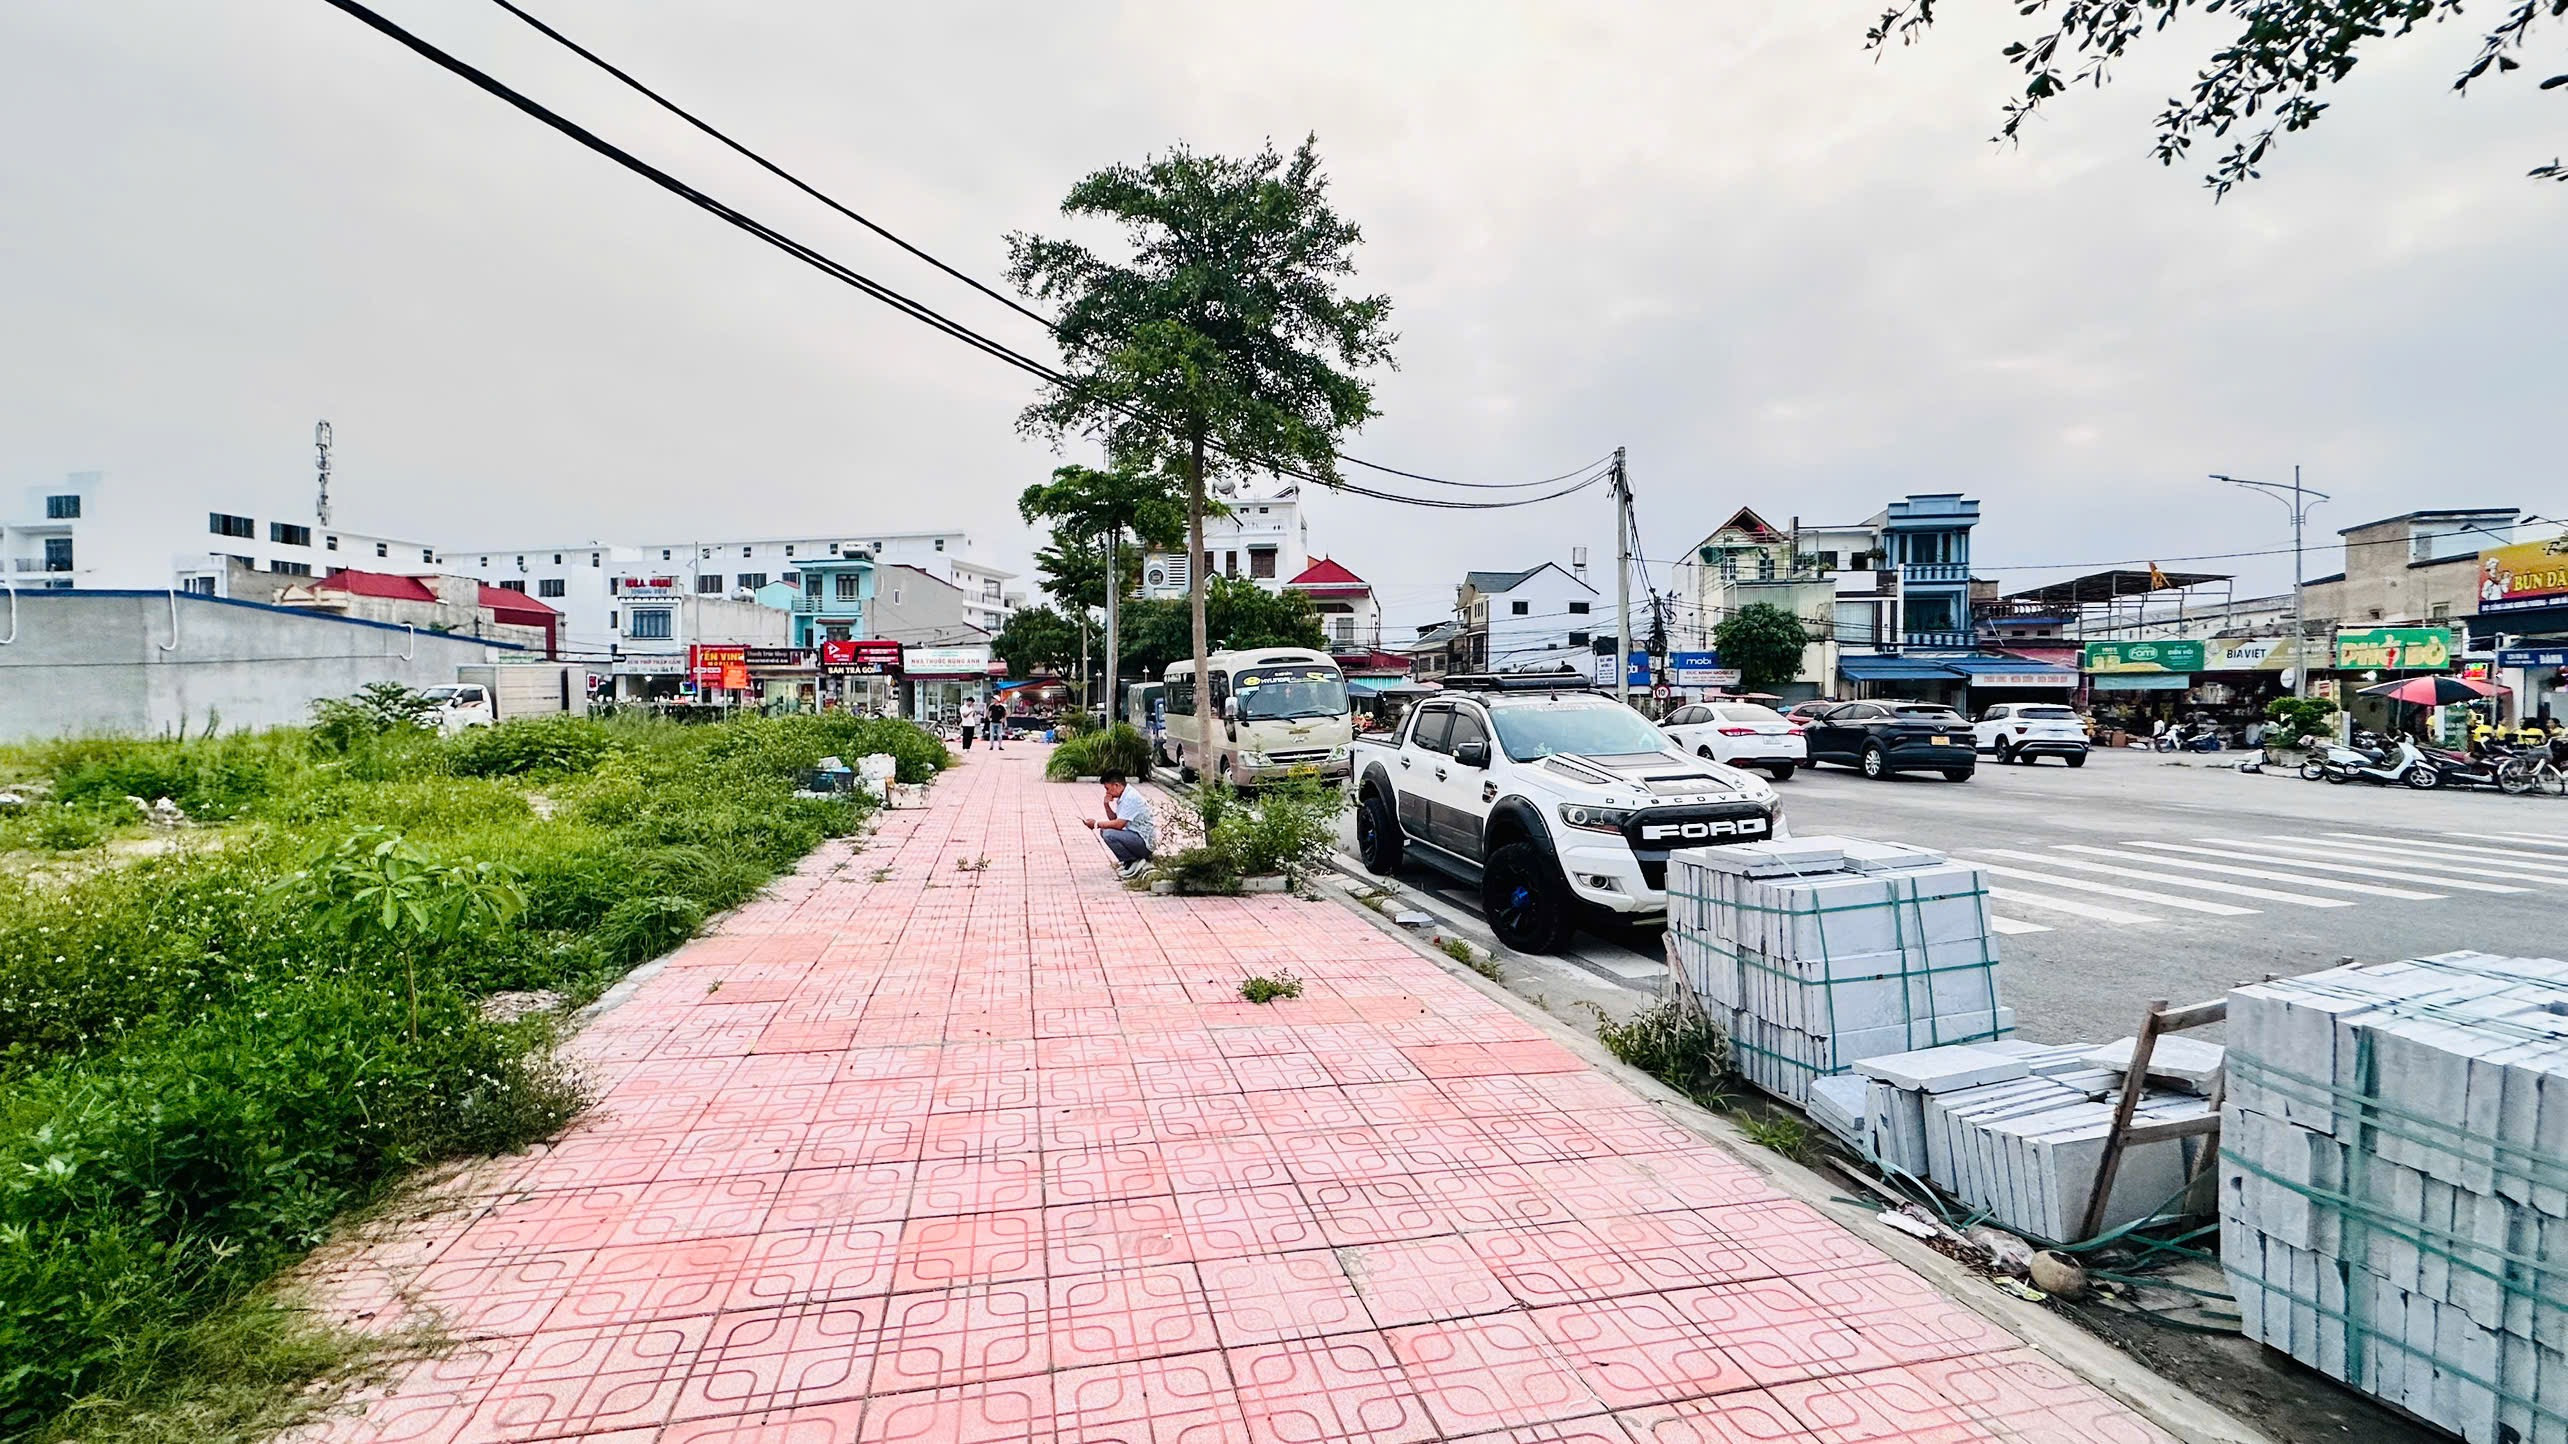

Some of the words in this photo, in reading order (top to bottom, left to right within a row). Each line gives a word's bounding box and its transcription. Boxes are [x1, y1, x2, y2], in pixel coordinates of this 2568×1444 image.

[2227, 649, 2245, 658] BIA
[2341, 634, 2401, 666] PHỞ
[2405, 636, 2446, 665] BÒ
[1606, 788, 1769, 806] DISCOVERY
[1642, 817, 1767, 840] FORD
